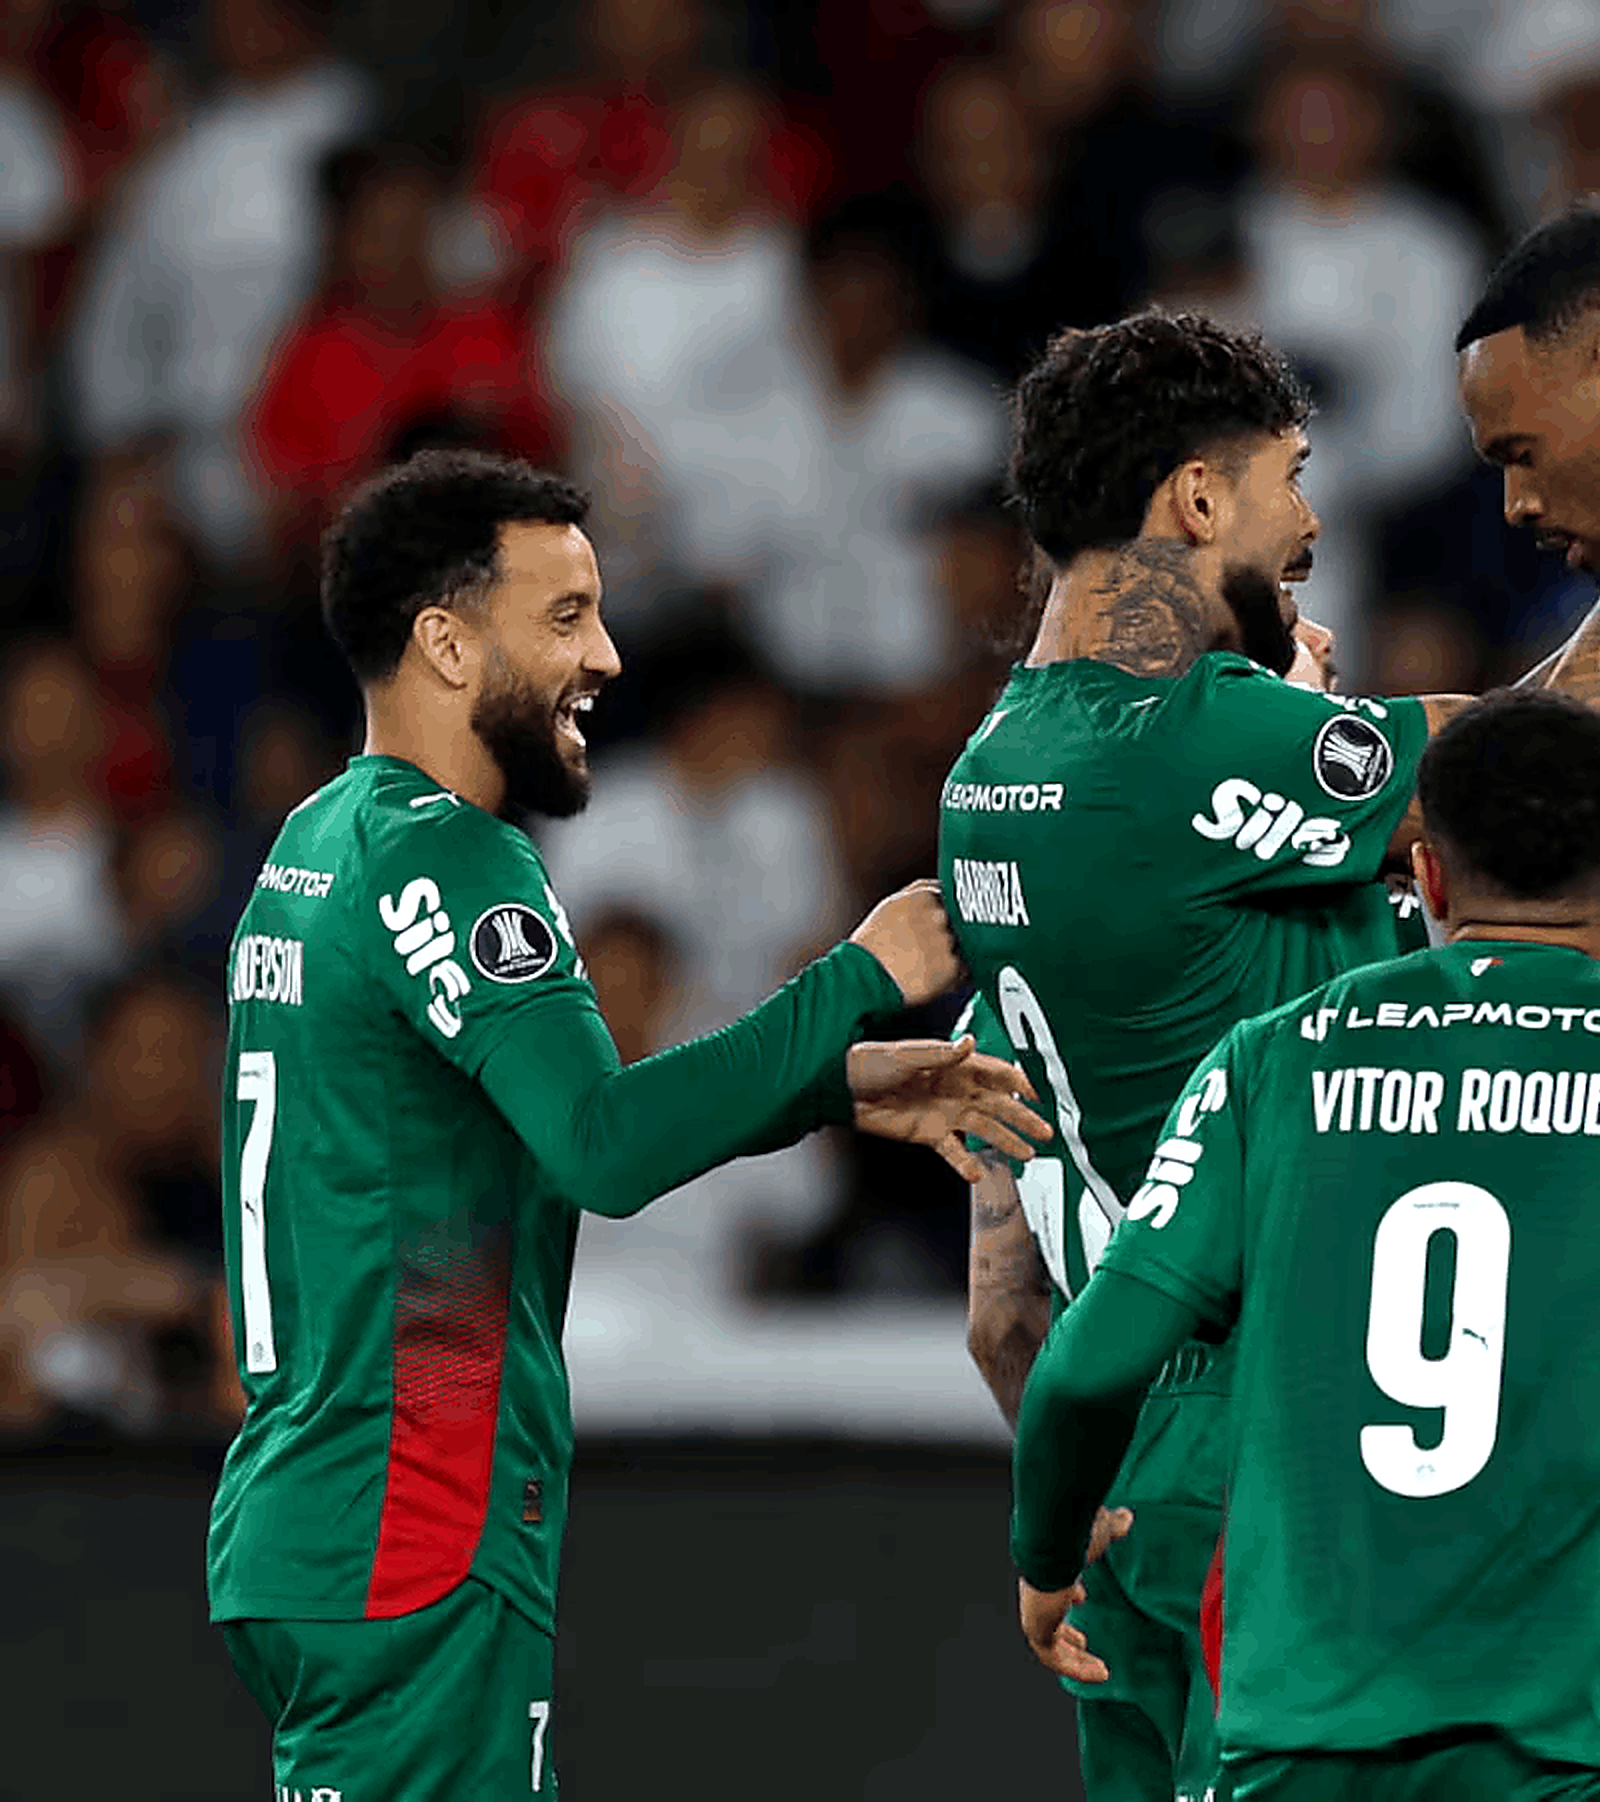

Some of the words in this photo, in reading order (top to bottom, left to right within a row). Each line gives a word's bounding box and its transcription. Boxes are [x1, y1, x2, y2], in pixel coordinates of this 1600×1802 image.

[231, 934, 304, 1006] NDERSON
[1312, 1067, 1444, 1134] VITOR
[236, 1051, 277, 1373] 7
[1360, 1181, 1511, 1498] 9
[529, 1700, 549, 1792] 7
